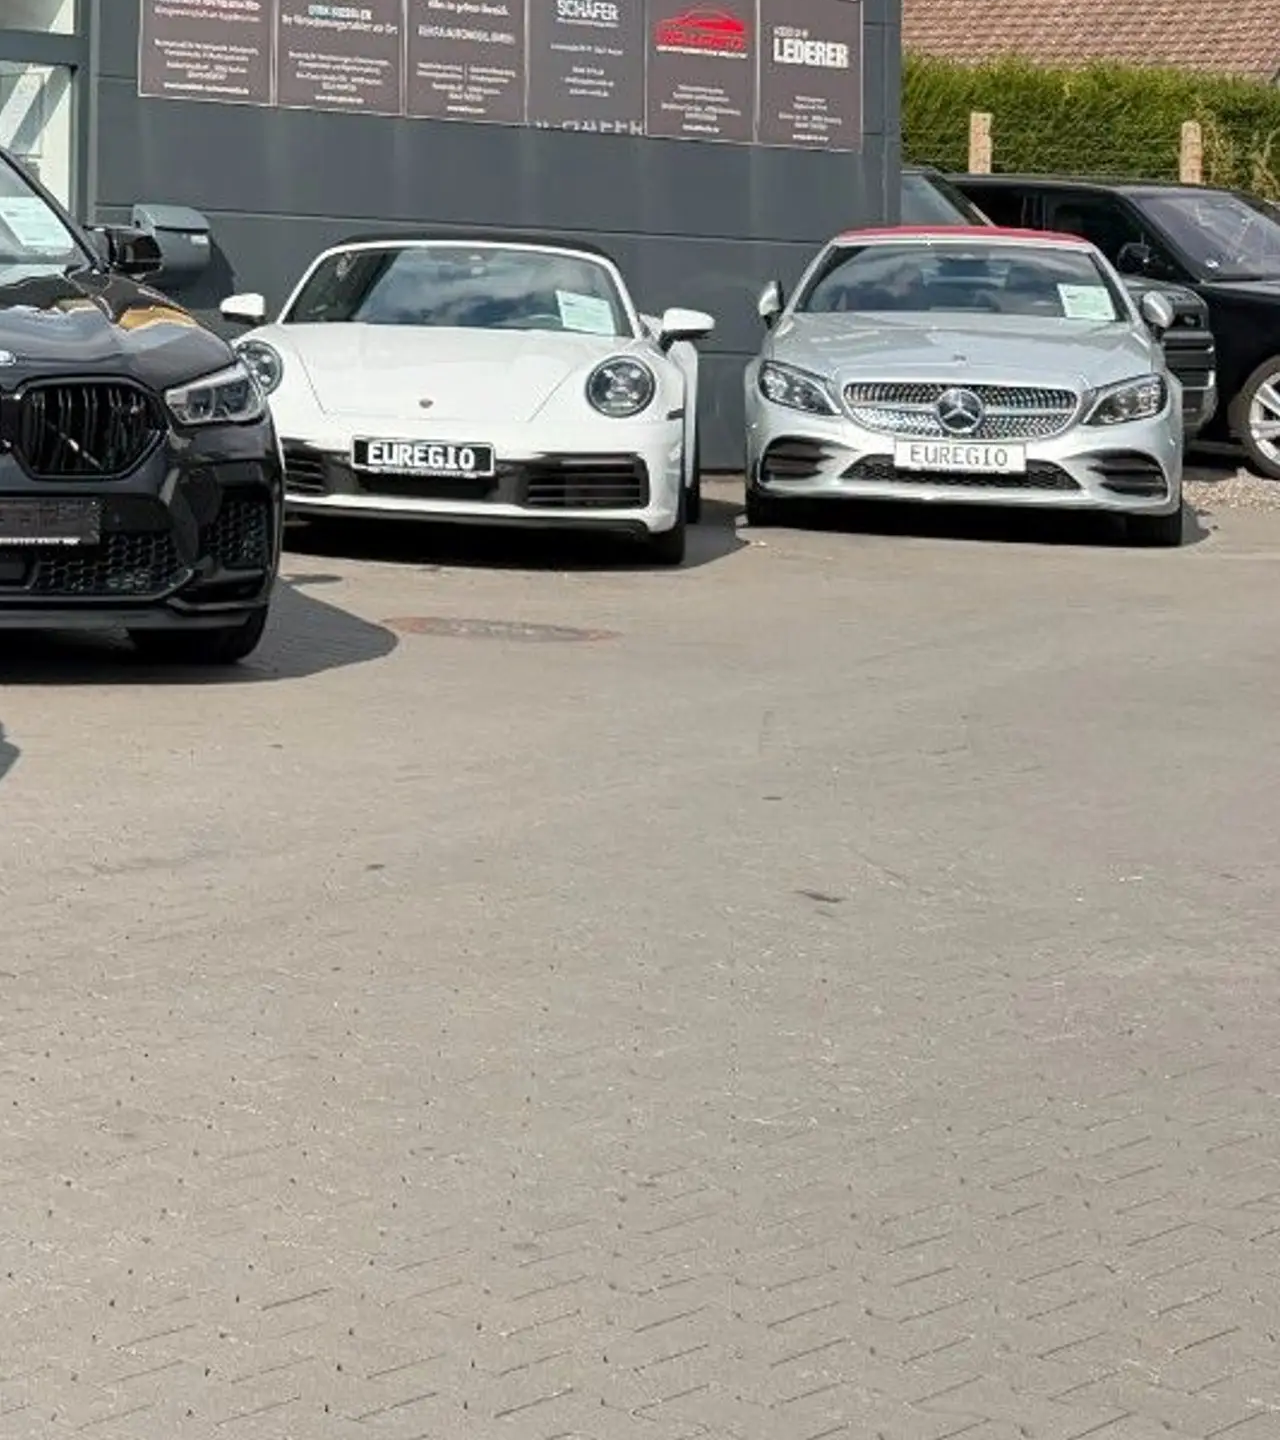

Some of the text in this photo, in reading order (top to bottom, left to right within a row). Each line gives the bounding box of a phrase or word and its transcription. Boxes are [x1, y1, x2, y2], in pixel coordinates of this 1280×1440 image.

[773, 38, 850, 69] LEDERER
[367, 442, 476, 470] EUREGIO
[910, 444, 1008, 467] EUREGIO
